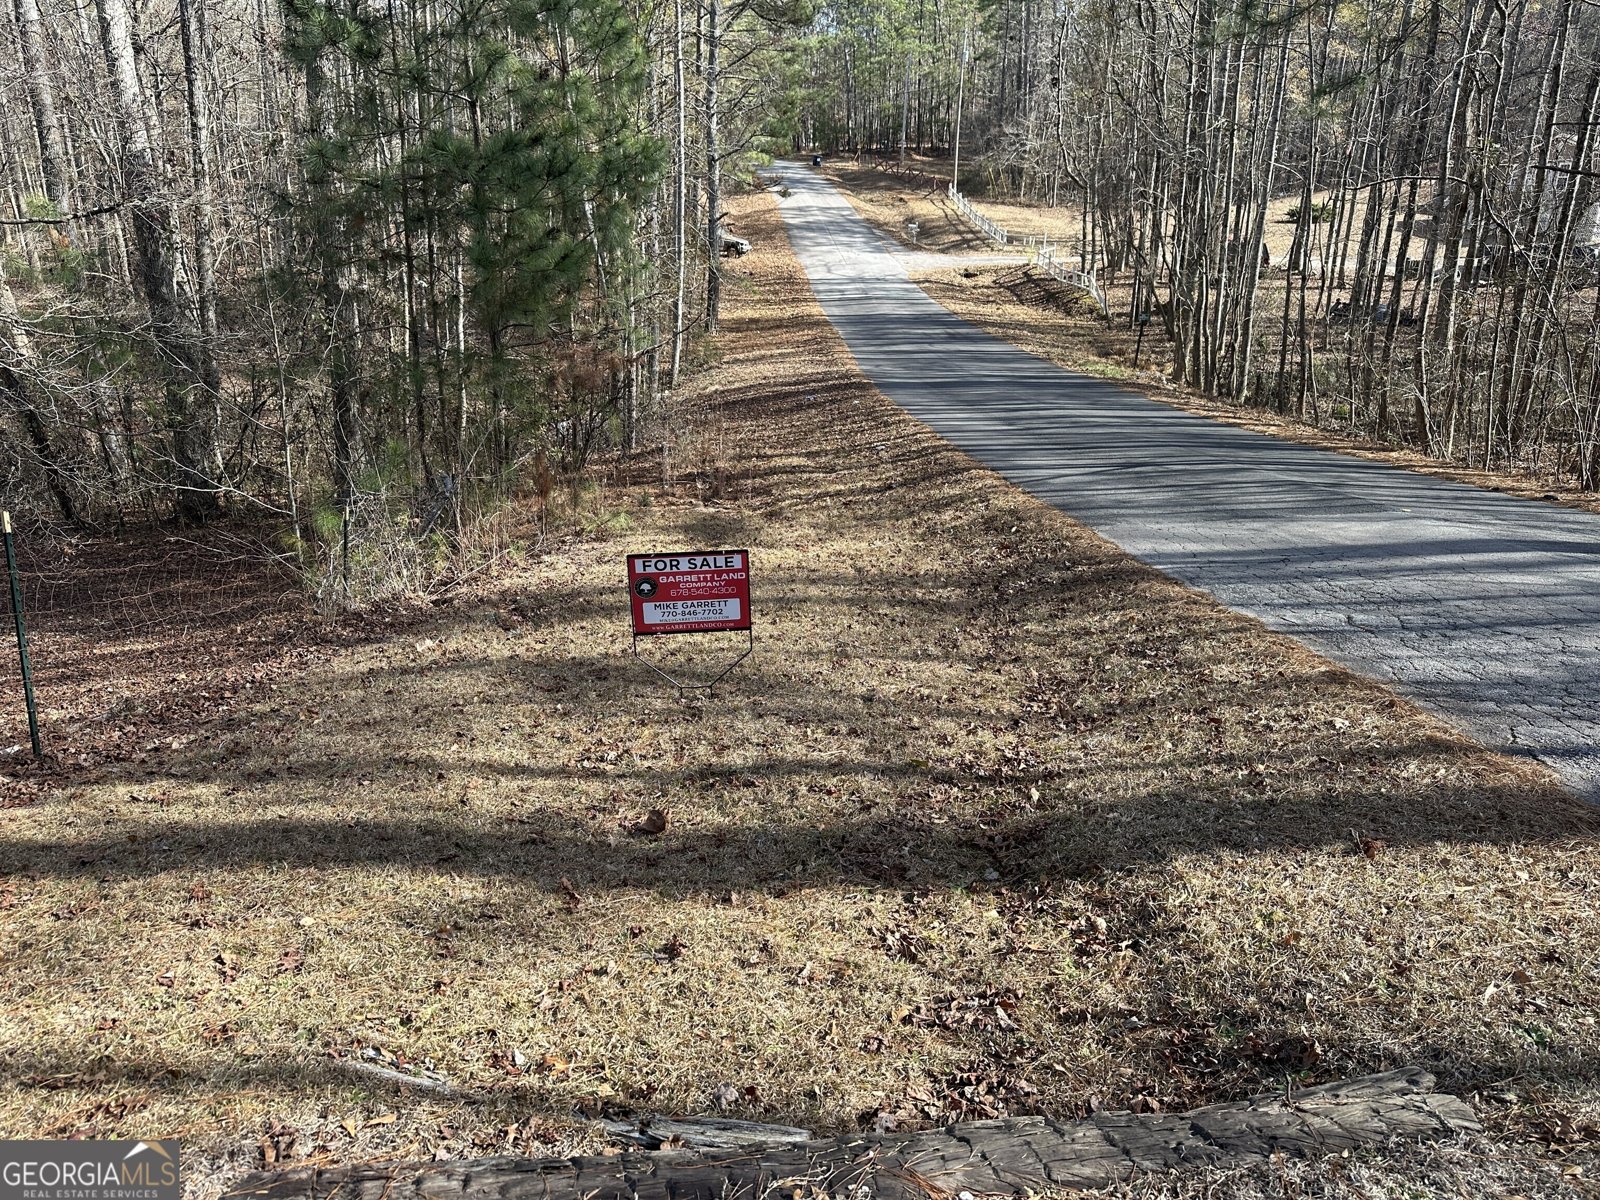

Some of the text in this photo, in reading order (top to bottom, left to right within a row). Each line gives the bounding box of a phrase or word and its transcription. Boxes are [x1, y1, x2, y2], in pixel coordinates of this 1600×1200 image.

[642, 556, 735, 572] FOR SALE
[659, 572, 746, 583] GARRETT LAND
[670, 586, 737, 597] 678-540-4300
[654, 600, 729, 611] MIKE GARRETT
[661, 609, 723, 618] 770-846-7702
